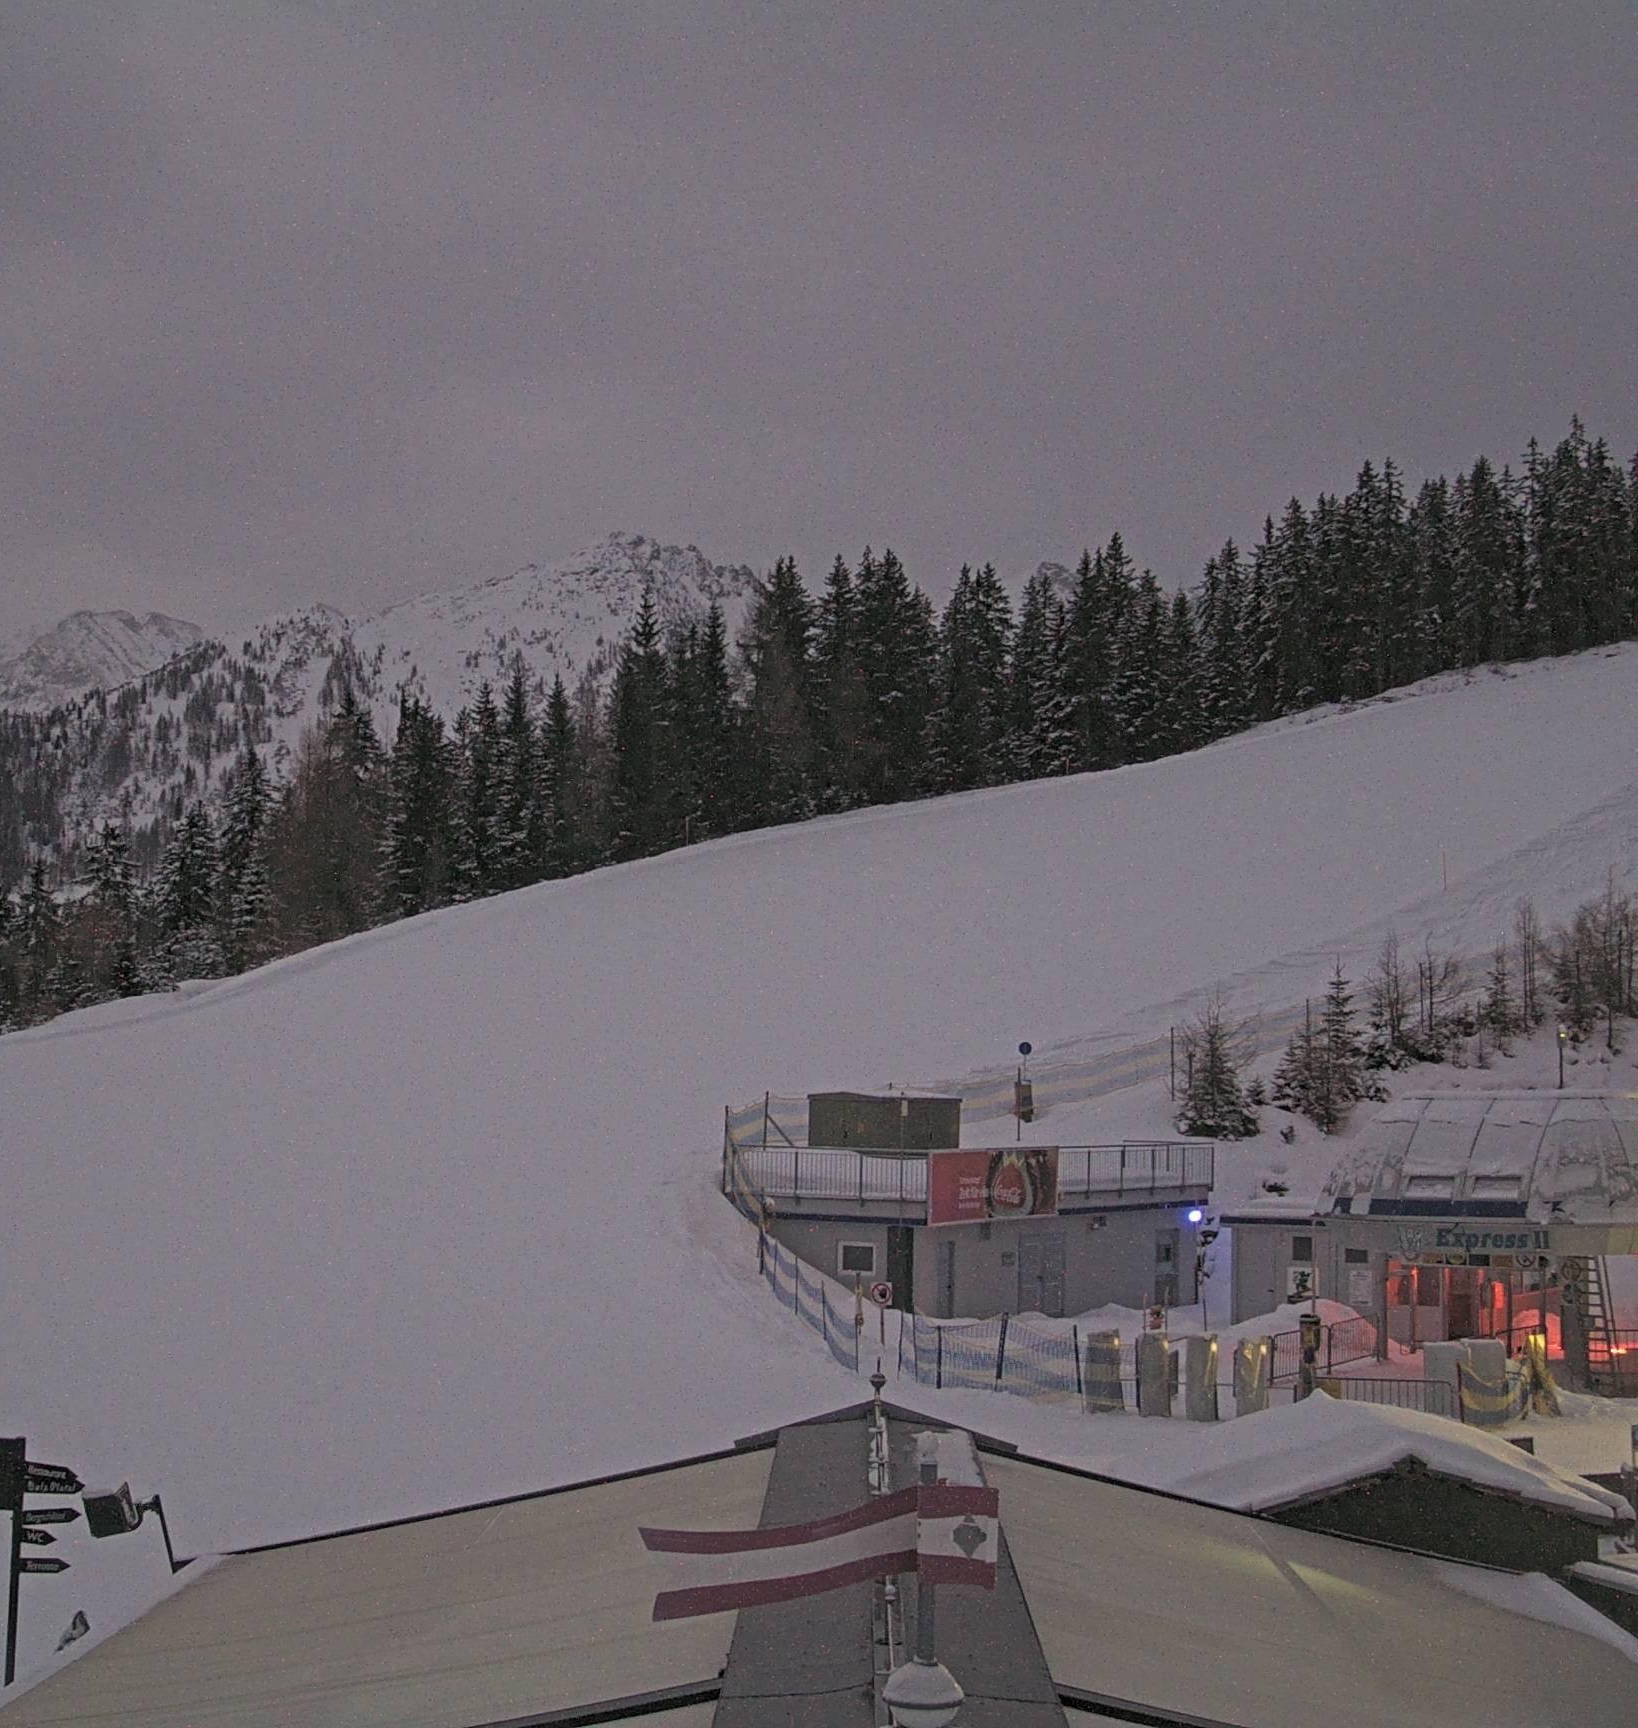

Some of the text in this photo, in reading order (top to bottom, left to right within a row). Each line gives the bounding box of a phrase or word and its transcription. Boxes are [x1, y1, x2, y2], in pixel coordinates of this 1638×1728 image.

[1436, 1227, 1550, 1251] Express II
[27, 1529, 45, 1543] WC
